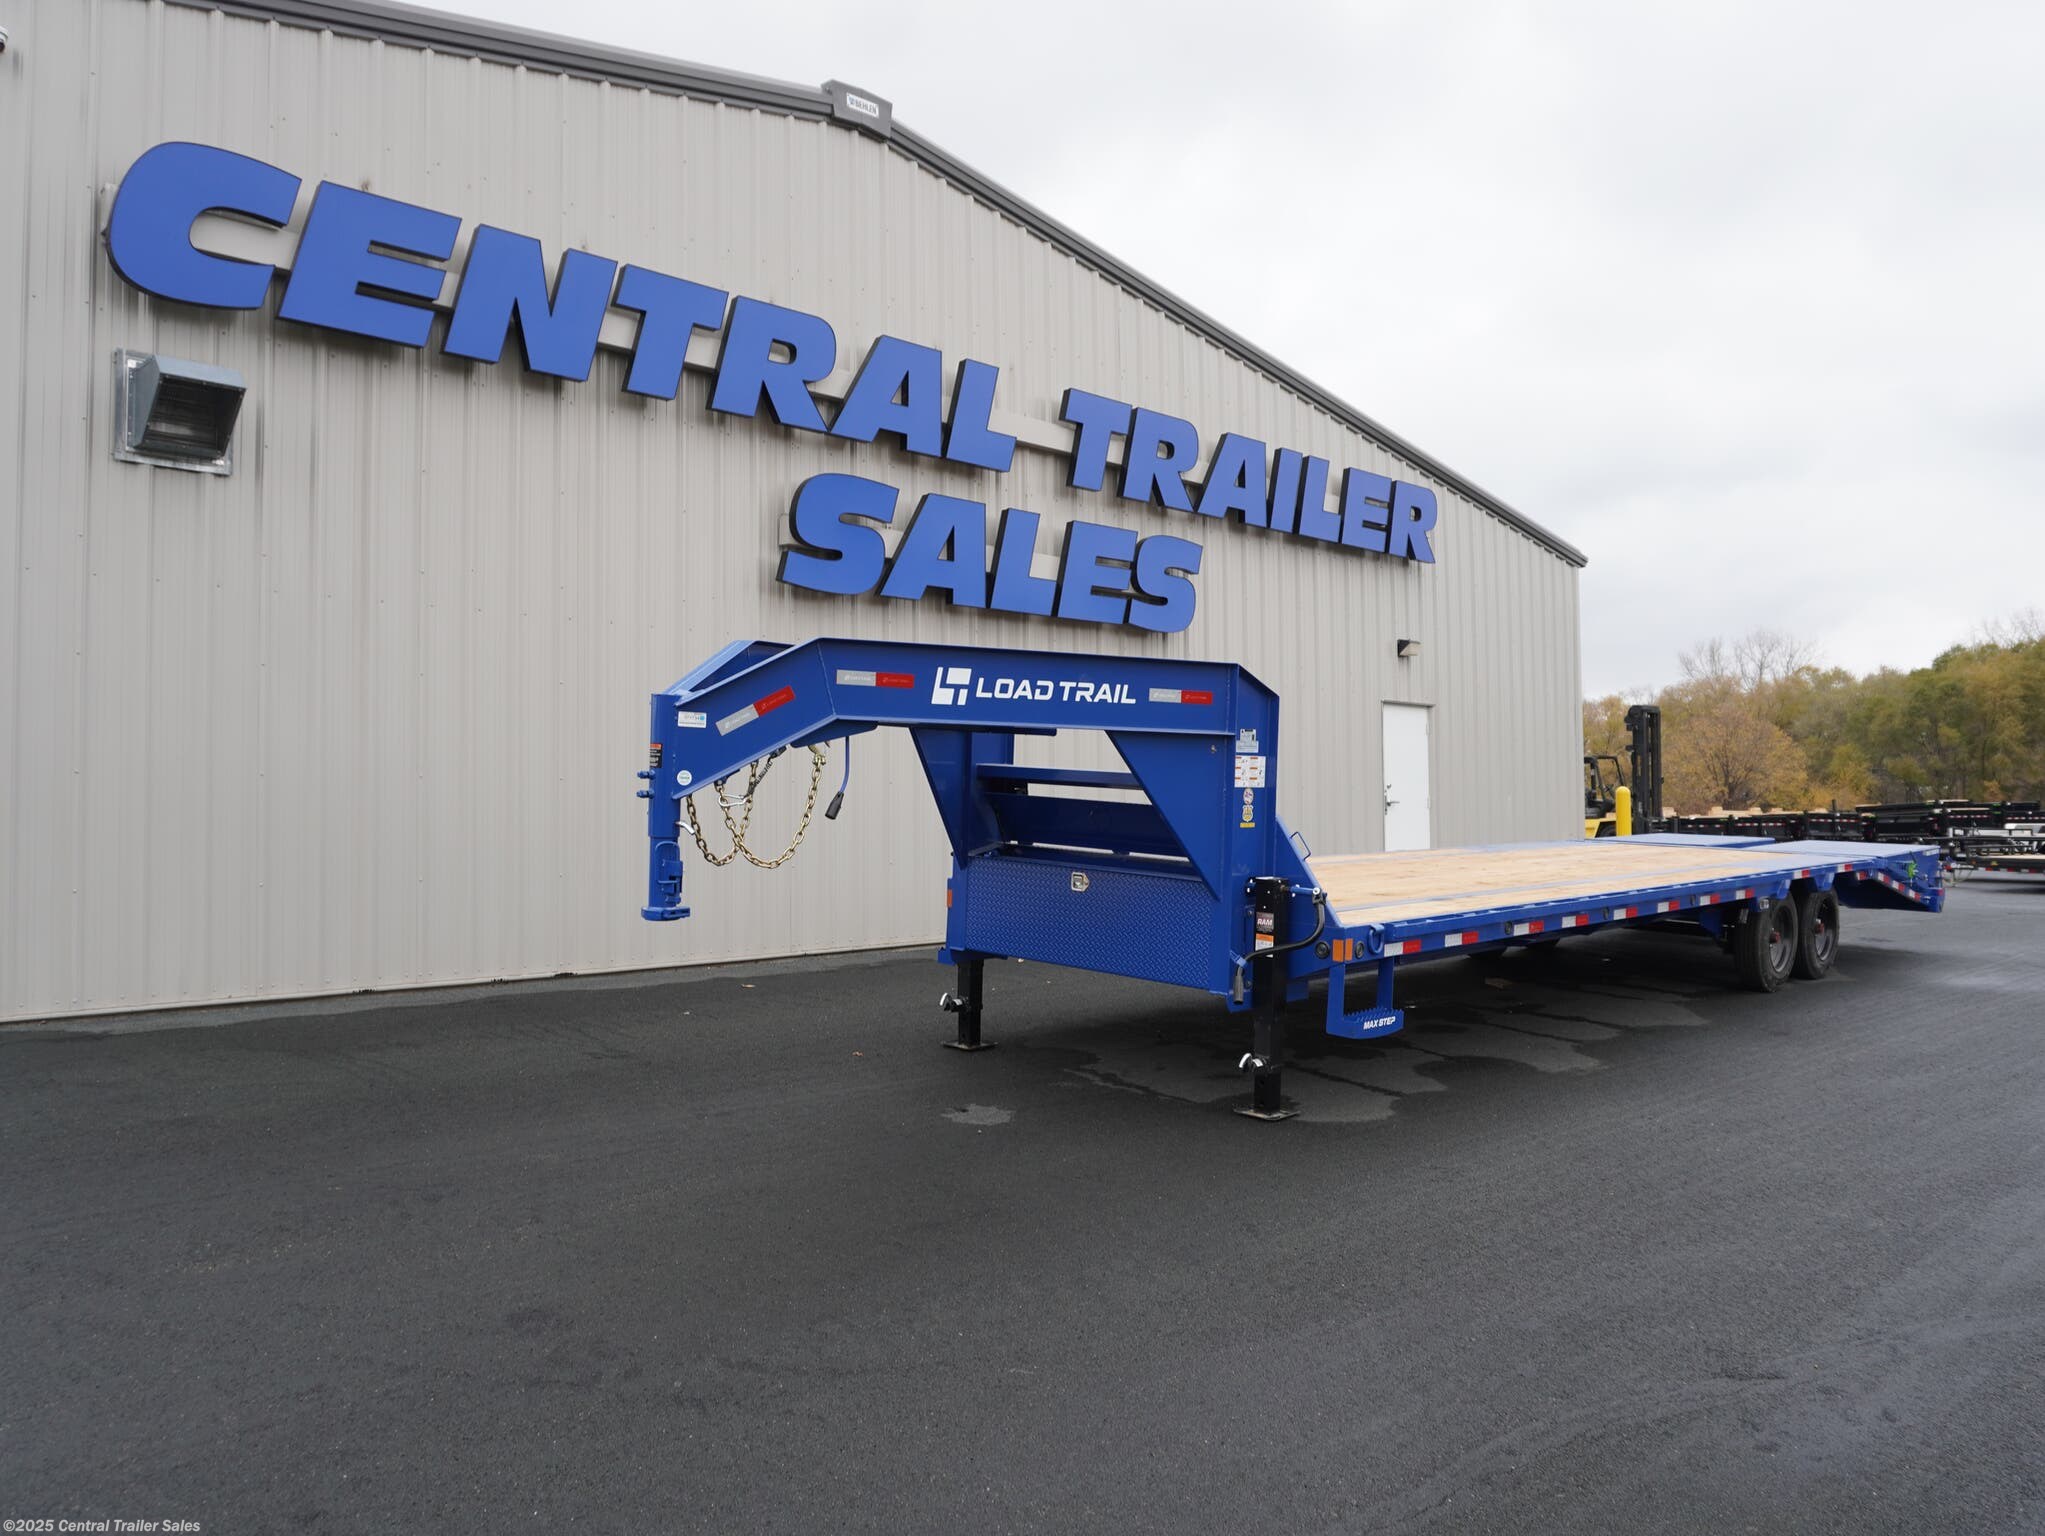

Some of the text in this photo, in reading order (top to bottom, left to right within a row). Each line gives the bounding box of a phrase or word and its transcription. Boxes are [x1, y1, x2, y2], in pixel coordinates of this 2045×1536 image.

[105, 141, 1438, 565] CENTRAL TRAILER
[776, 473, 1204, 634] SALES
[975, 677, 1054, 701] LOAD
[1059, 681, 1137, 705] TRAIL
[1256, 918, 1273, 926] RAM
[1363, 1016, 1396, 1030] MAX STEP
